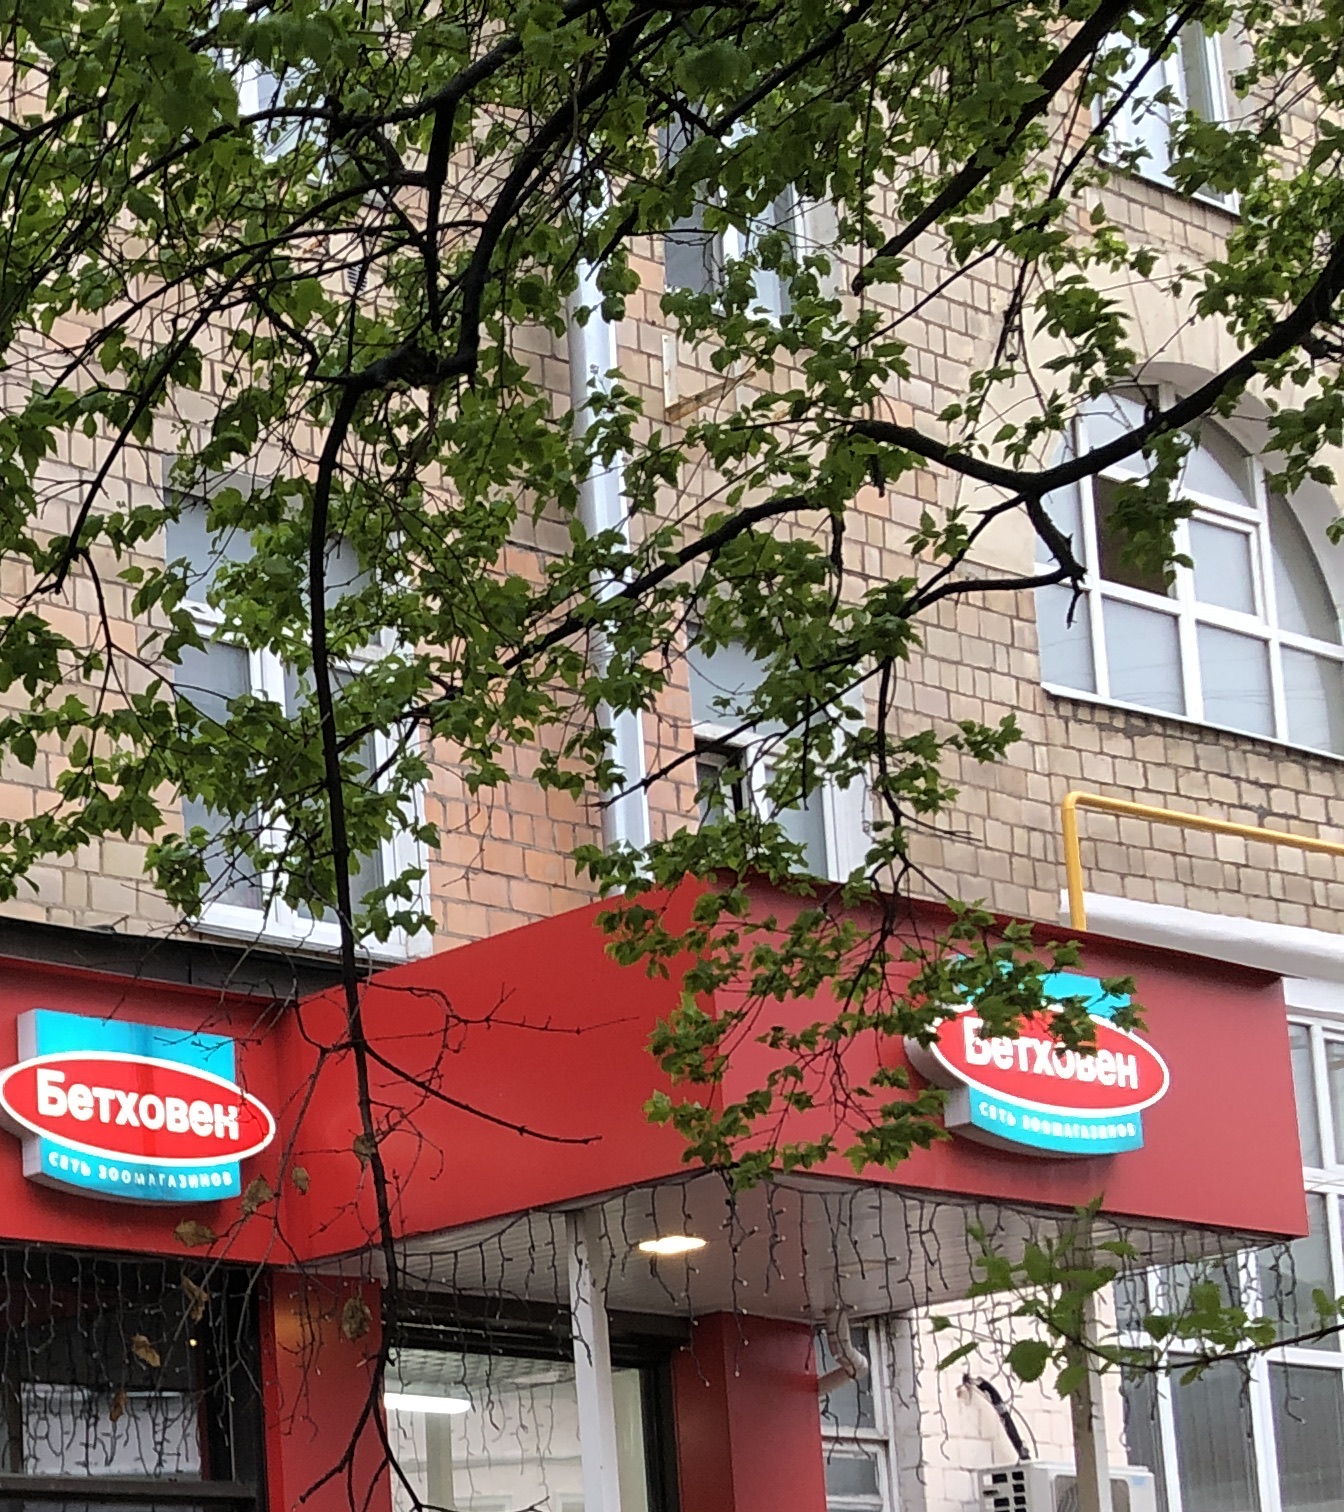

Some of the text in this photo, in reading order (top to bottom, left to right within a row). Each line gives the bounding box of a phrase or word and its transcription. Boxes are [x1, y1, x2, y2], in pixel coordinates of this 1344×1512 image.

[963, 1015, 1139, 1090] Бетховен
[36, 1067, 240, 1141] Бетховен
[48, 1151, 233, 1189] СЕТЬ ЗООМАГАЗИНОВ
